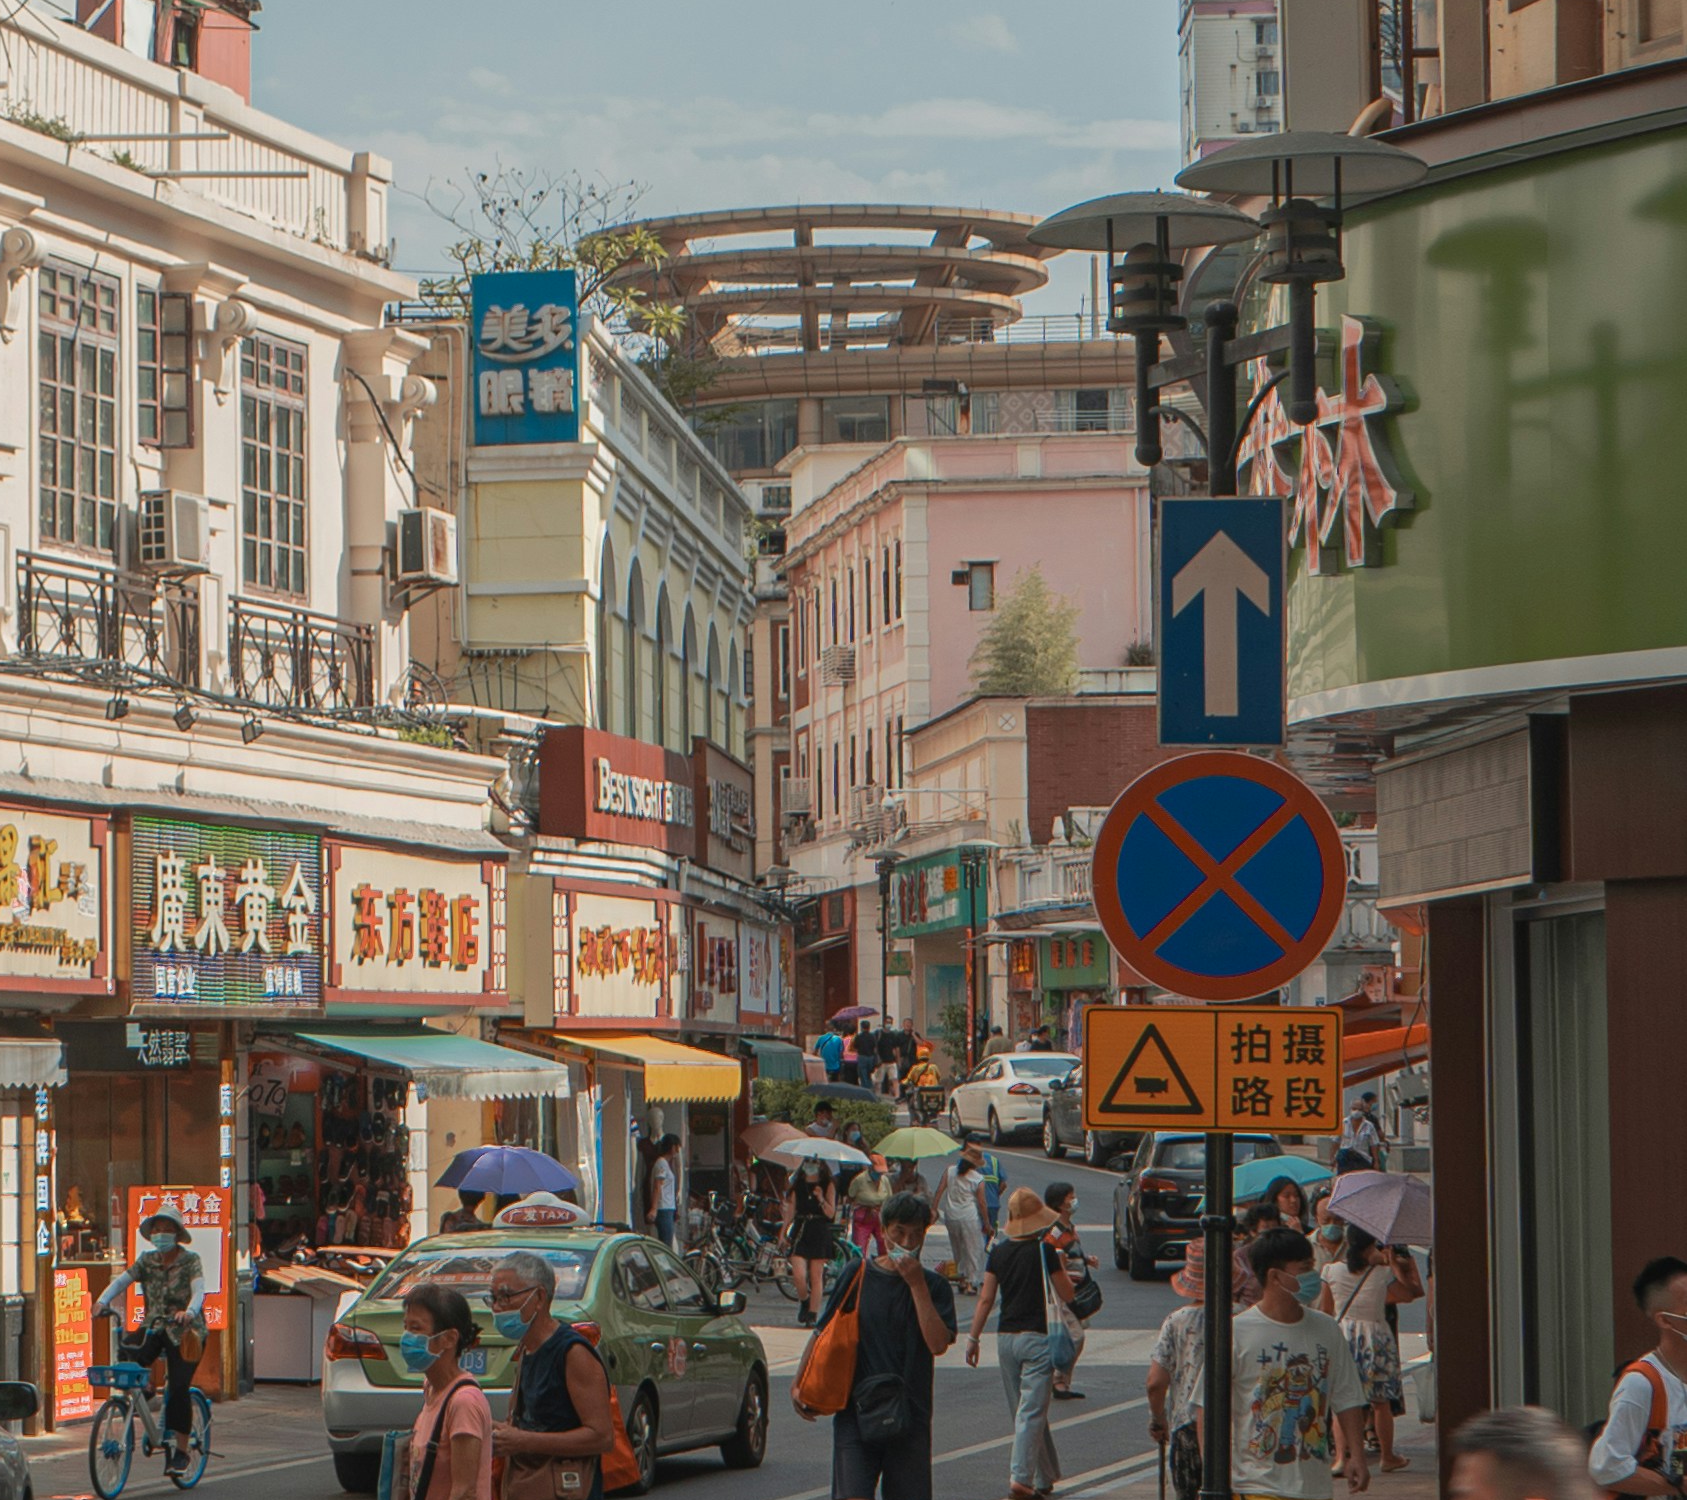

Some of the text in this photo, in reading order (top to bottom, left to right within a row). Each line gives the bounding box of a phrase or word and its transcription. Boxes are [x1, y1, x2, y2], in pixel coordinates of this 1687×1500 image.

[479, 367, 574, 416] 眼镜
[352, 883, 480, 968] 东方鞋店
[1230, 1022, 1326, 1066] 拍摄
[1230, 1075, 1326, 1118] 路段
[540, 1210, 571, 1221] TAXI
